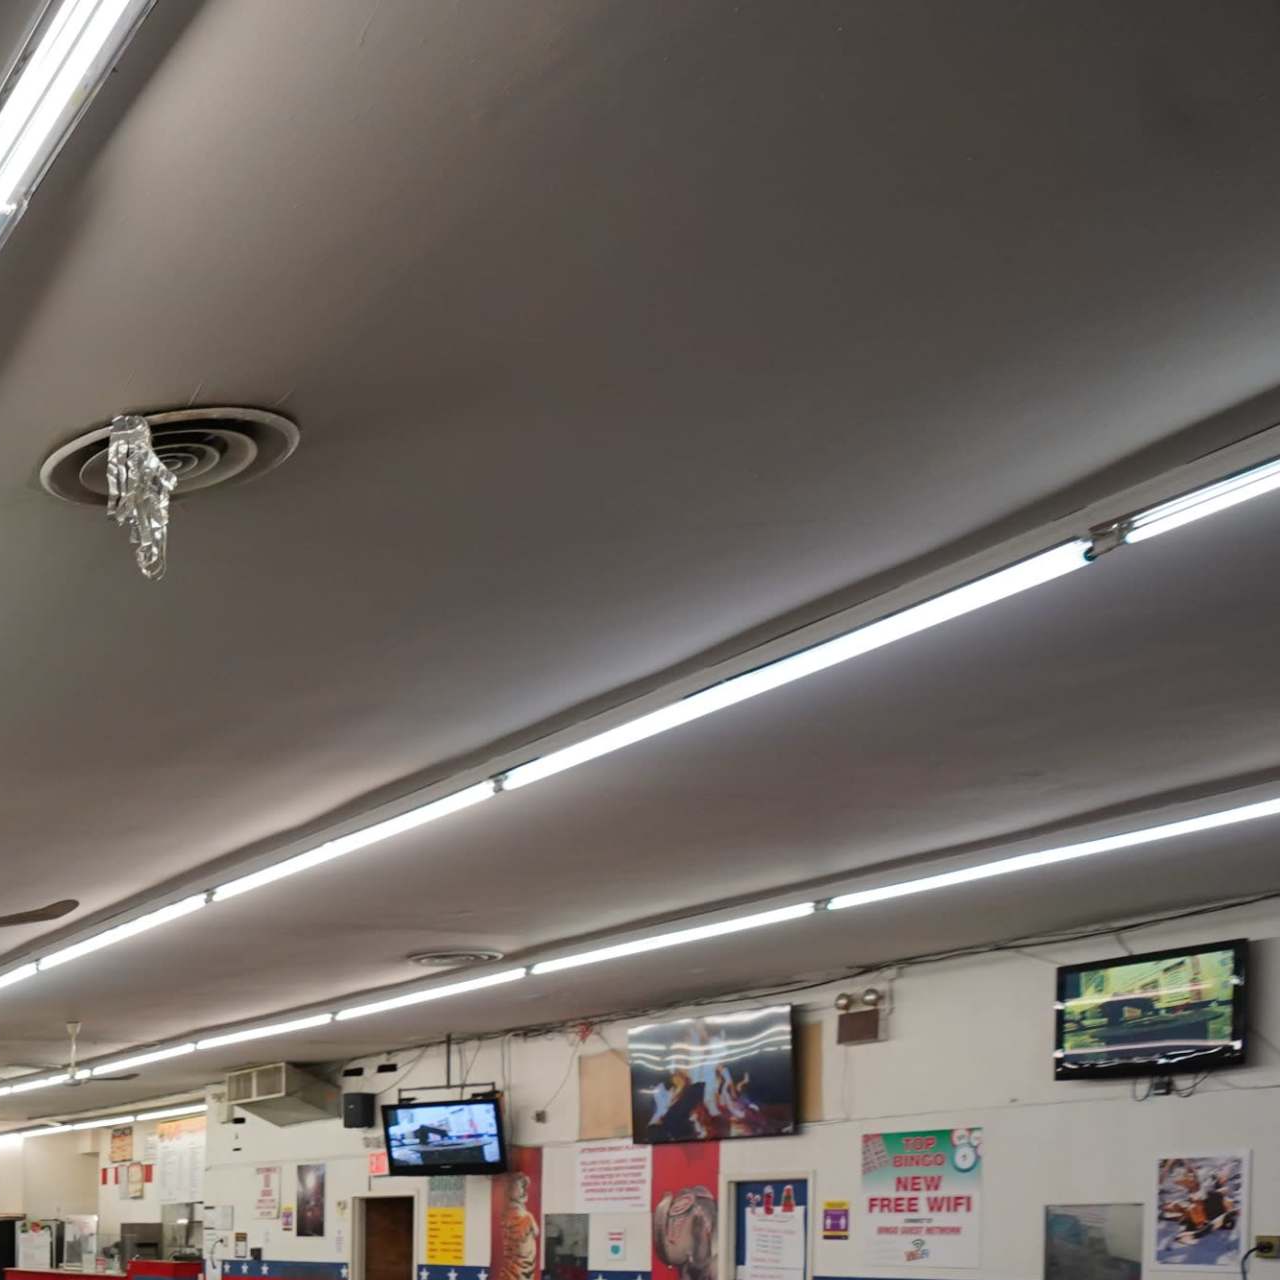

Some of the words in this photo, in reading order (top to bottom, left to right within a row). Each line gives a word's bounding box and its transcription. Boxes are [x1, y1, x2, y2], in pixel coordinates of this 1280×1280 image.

[903, 1136, 936, 1151] TOP
[892, 1154, 946, 1168] BINGO
[895, 1176, 943, 1192] NEW
[868, 1197, 920, 1213] FREE
[925, 1196, 972, 1213] WIFI
